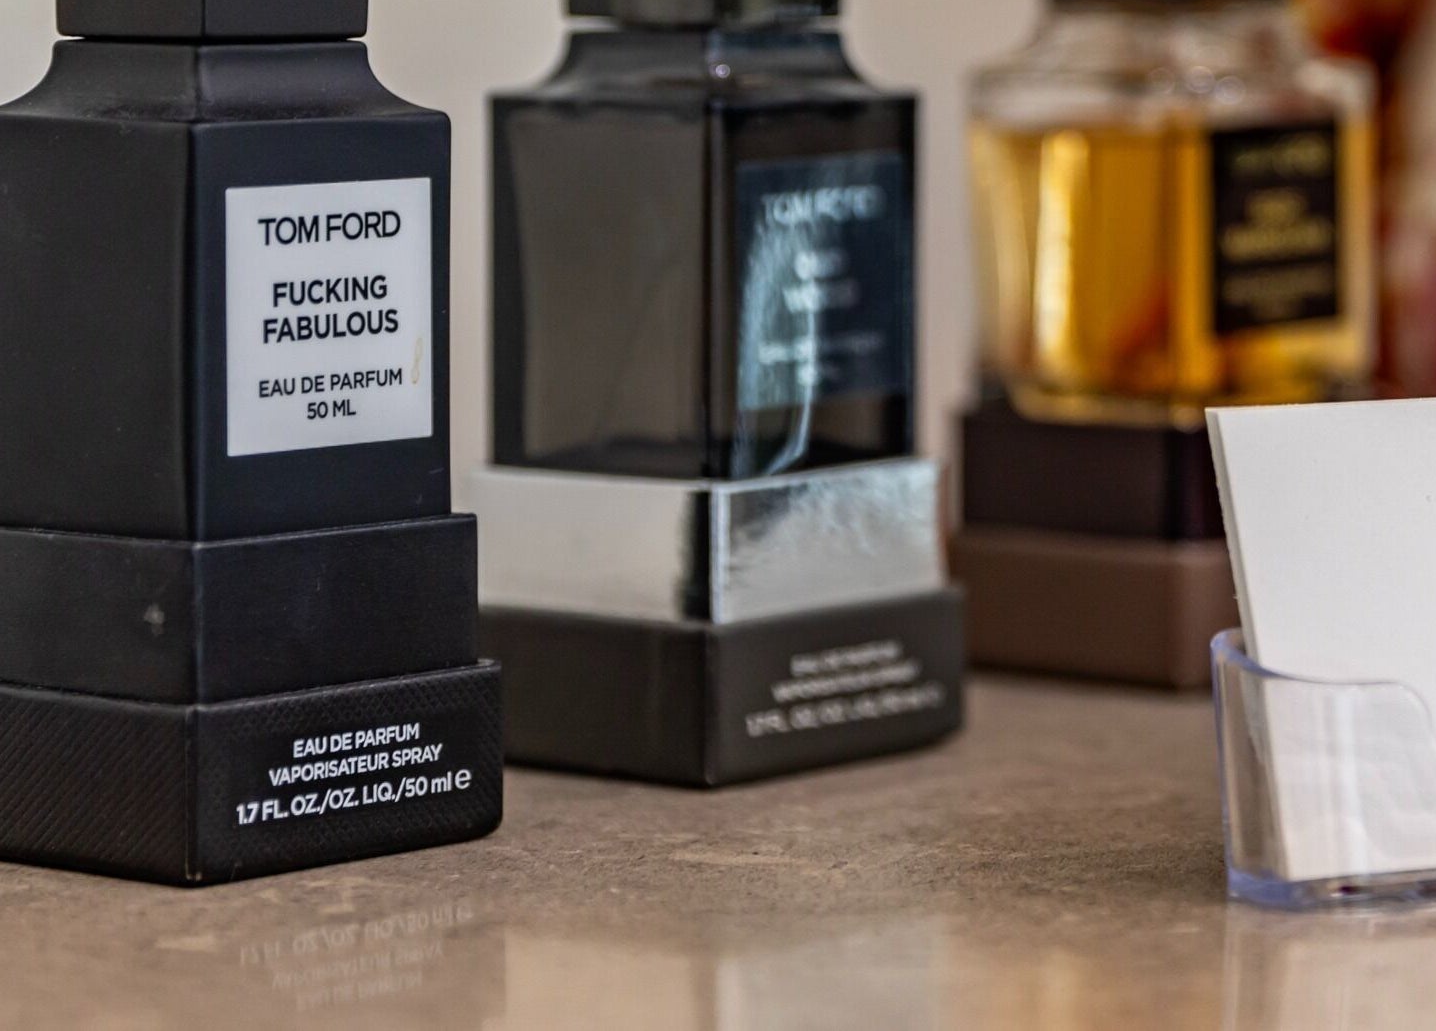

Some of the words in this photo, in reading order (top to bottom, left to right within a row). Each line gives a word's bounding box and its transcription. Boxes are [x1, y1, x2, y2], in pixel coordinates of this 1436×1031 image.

[258, 215, 320, 246] TOM
[325, 210, 401, 241] FORD
[272, 274, 388, 308] FUCKING
[262, 308, 399, 344] FABULOUS
[258, 377, 296, 398] EAU
[301, 375, 325, 394] DE
[330, 368, 403, 391] PARFUM
[306, 401, 329, 420] 50
[332, 399, 356, 417] ML
[292, 738, 327, 758] EAU
[330, 734, 353, 752] DE
[355, 722, 420, 749] PARFUM
[268, 752, 390, 787] VAPORISATEUR
[391, 743, 443, 767] SPRAY
[235, 802, 260, 824] 1.7
[261, 799, 288, 820] FL.
